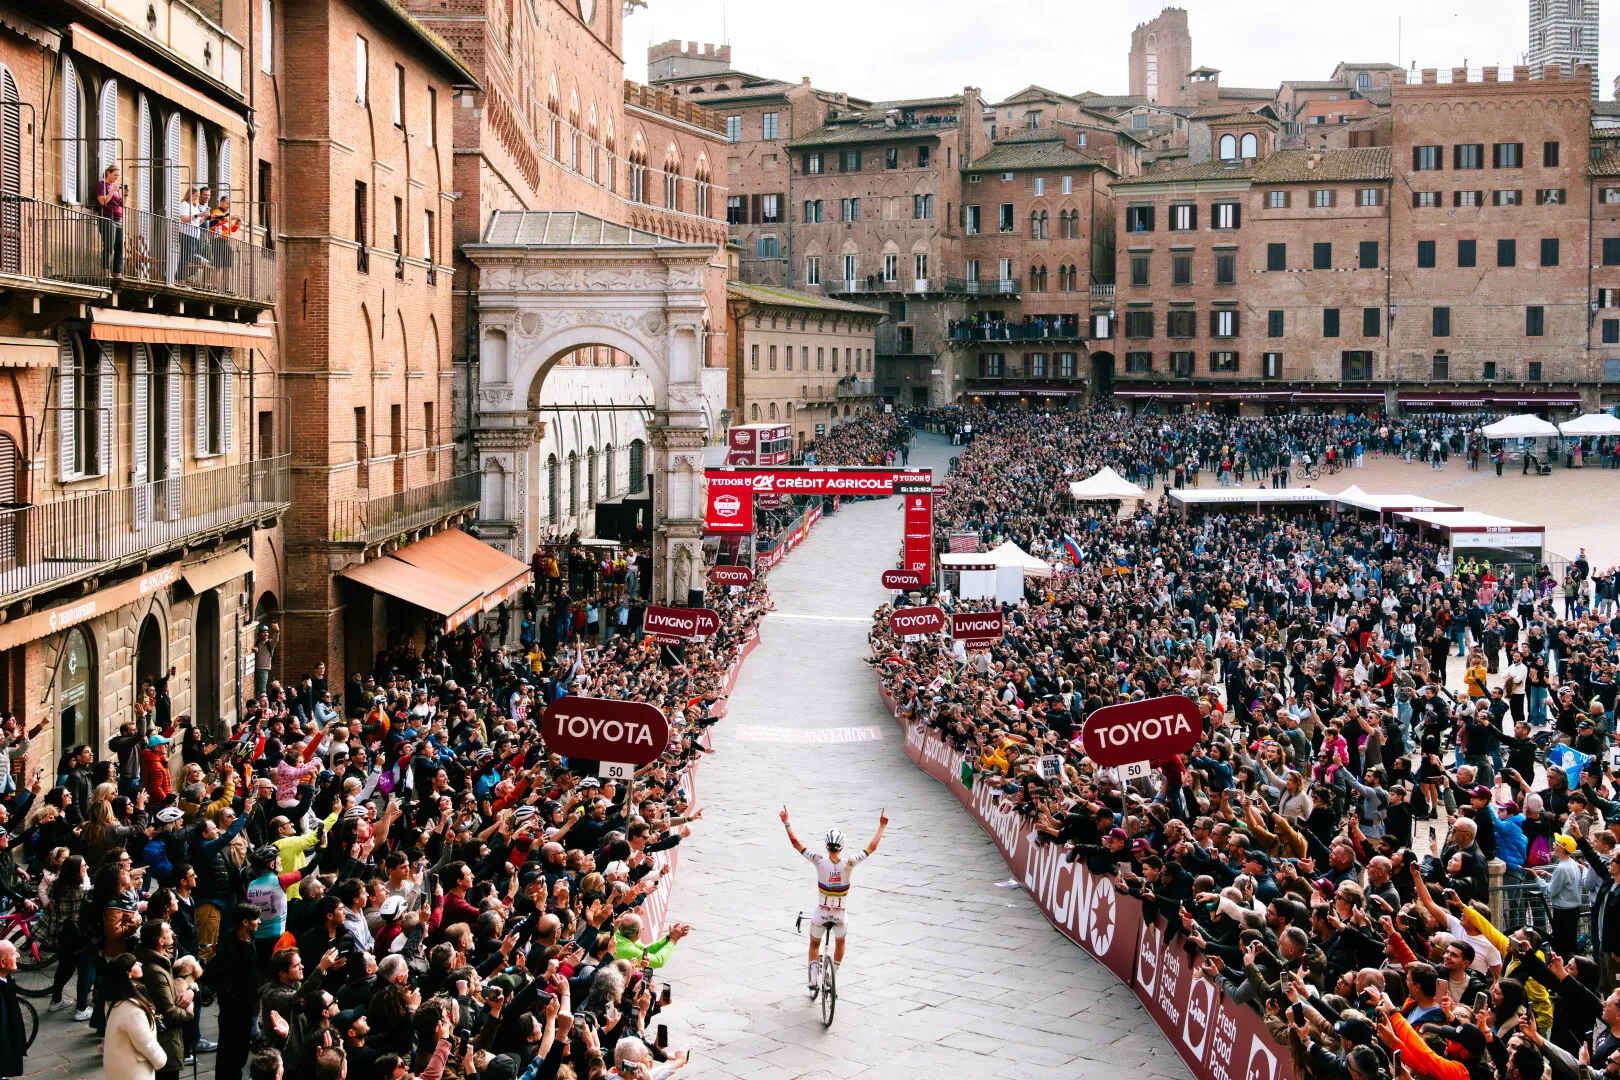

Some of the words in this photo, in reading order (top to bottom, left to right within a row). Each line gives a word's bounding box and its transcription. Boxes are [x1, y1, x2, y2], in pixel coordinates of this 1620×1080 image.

[711, 478, 744, 486] TUDOR
[776, 476, 824, 489] CRÉDIT
[826, 479, 893, 489] AGRICOLE
[715, 571, 749, 581] TOYOTA
[885, 575, 919, 584] TOYOTA
[648, 614, 694, 630] LIVIGNO
[894, 614, 940, 628] TOYOTA
[955, 620, 1000, 632] LIVIGNO
[656, 636, 680, 645] LIVIGNO
[966, 640, 990, 648] LIVIGNO
[554, 714, 654, 747] TOYOTA
[804, 727, 874, 743] LAURETANA
[1094, 713, 1192, 749] TOYOTA
[608, 766, 623, 778] 50
[1128, 765, 1141, 776] 50
[823, 895, 828, 906] 1
[837, 897, 842, 908] 1
[1163, 946, 1180, 978] Fresh
[1161, 965, 1177, 998] Food
[1158, 988, 1180, 1026] Partner
[1217, 1004, 1237, 1043] Fresh
[1213, 1028, 1233, 1066] Food
